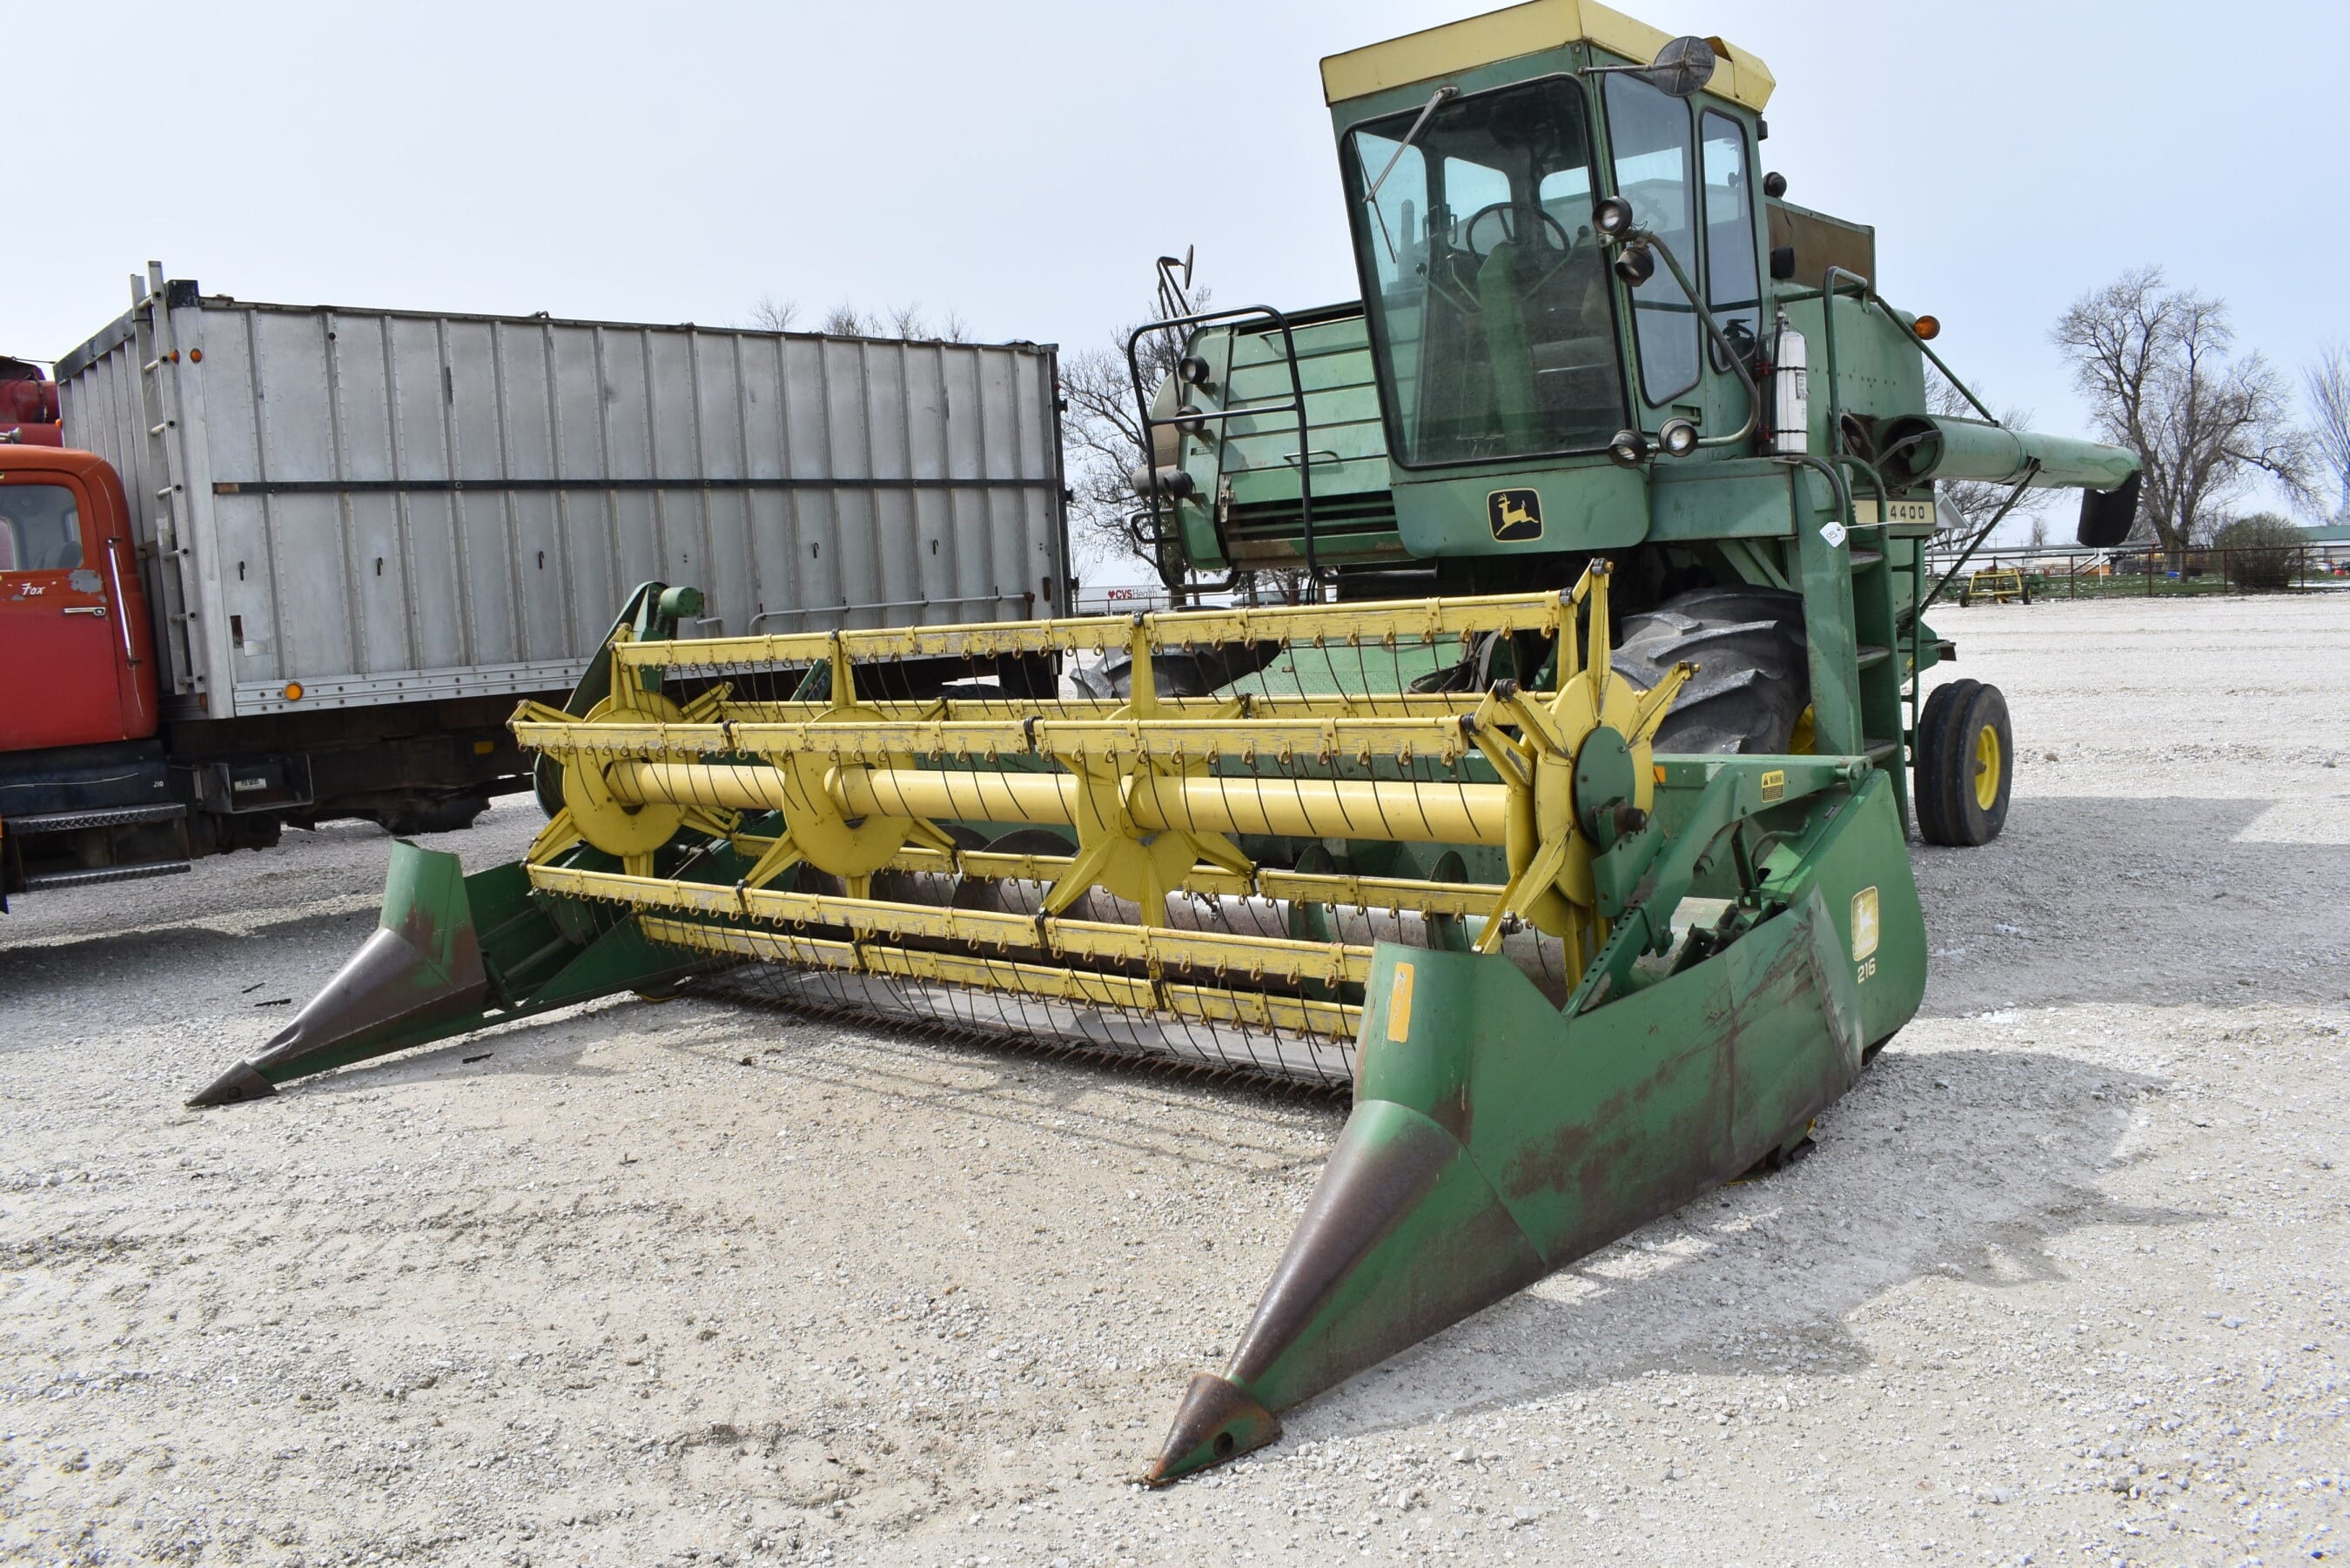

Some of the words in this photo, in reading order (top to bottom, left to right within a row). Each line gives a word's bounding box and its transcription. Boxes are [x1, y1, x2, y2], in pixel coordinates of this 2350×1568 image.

[1890, 505, 1925, 519] 4400
[1115, 589, 1132, 600] CVS
[1857, 956, 1876, 985] 216
